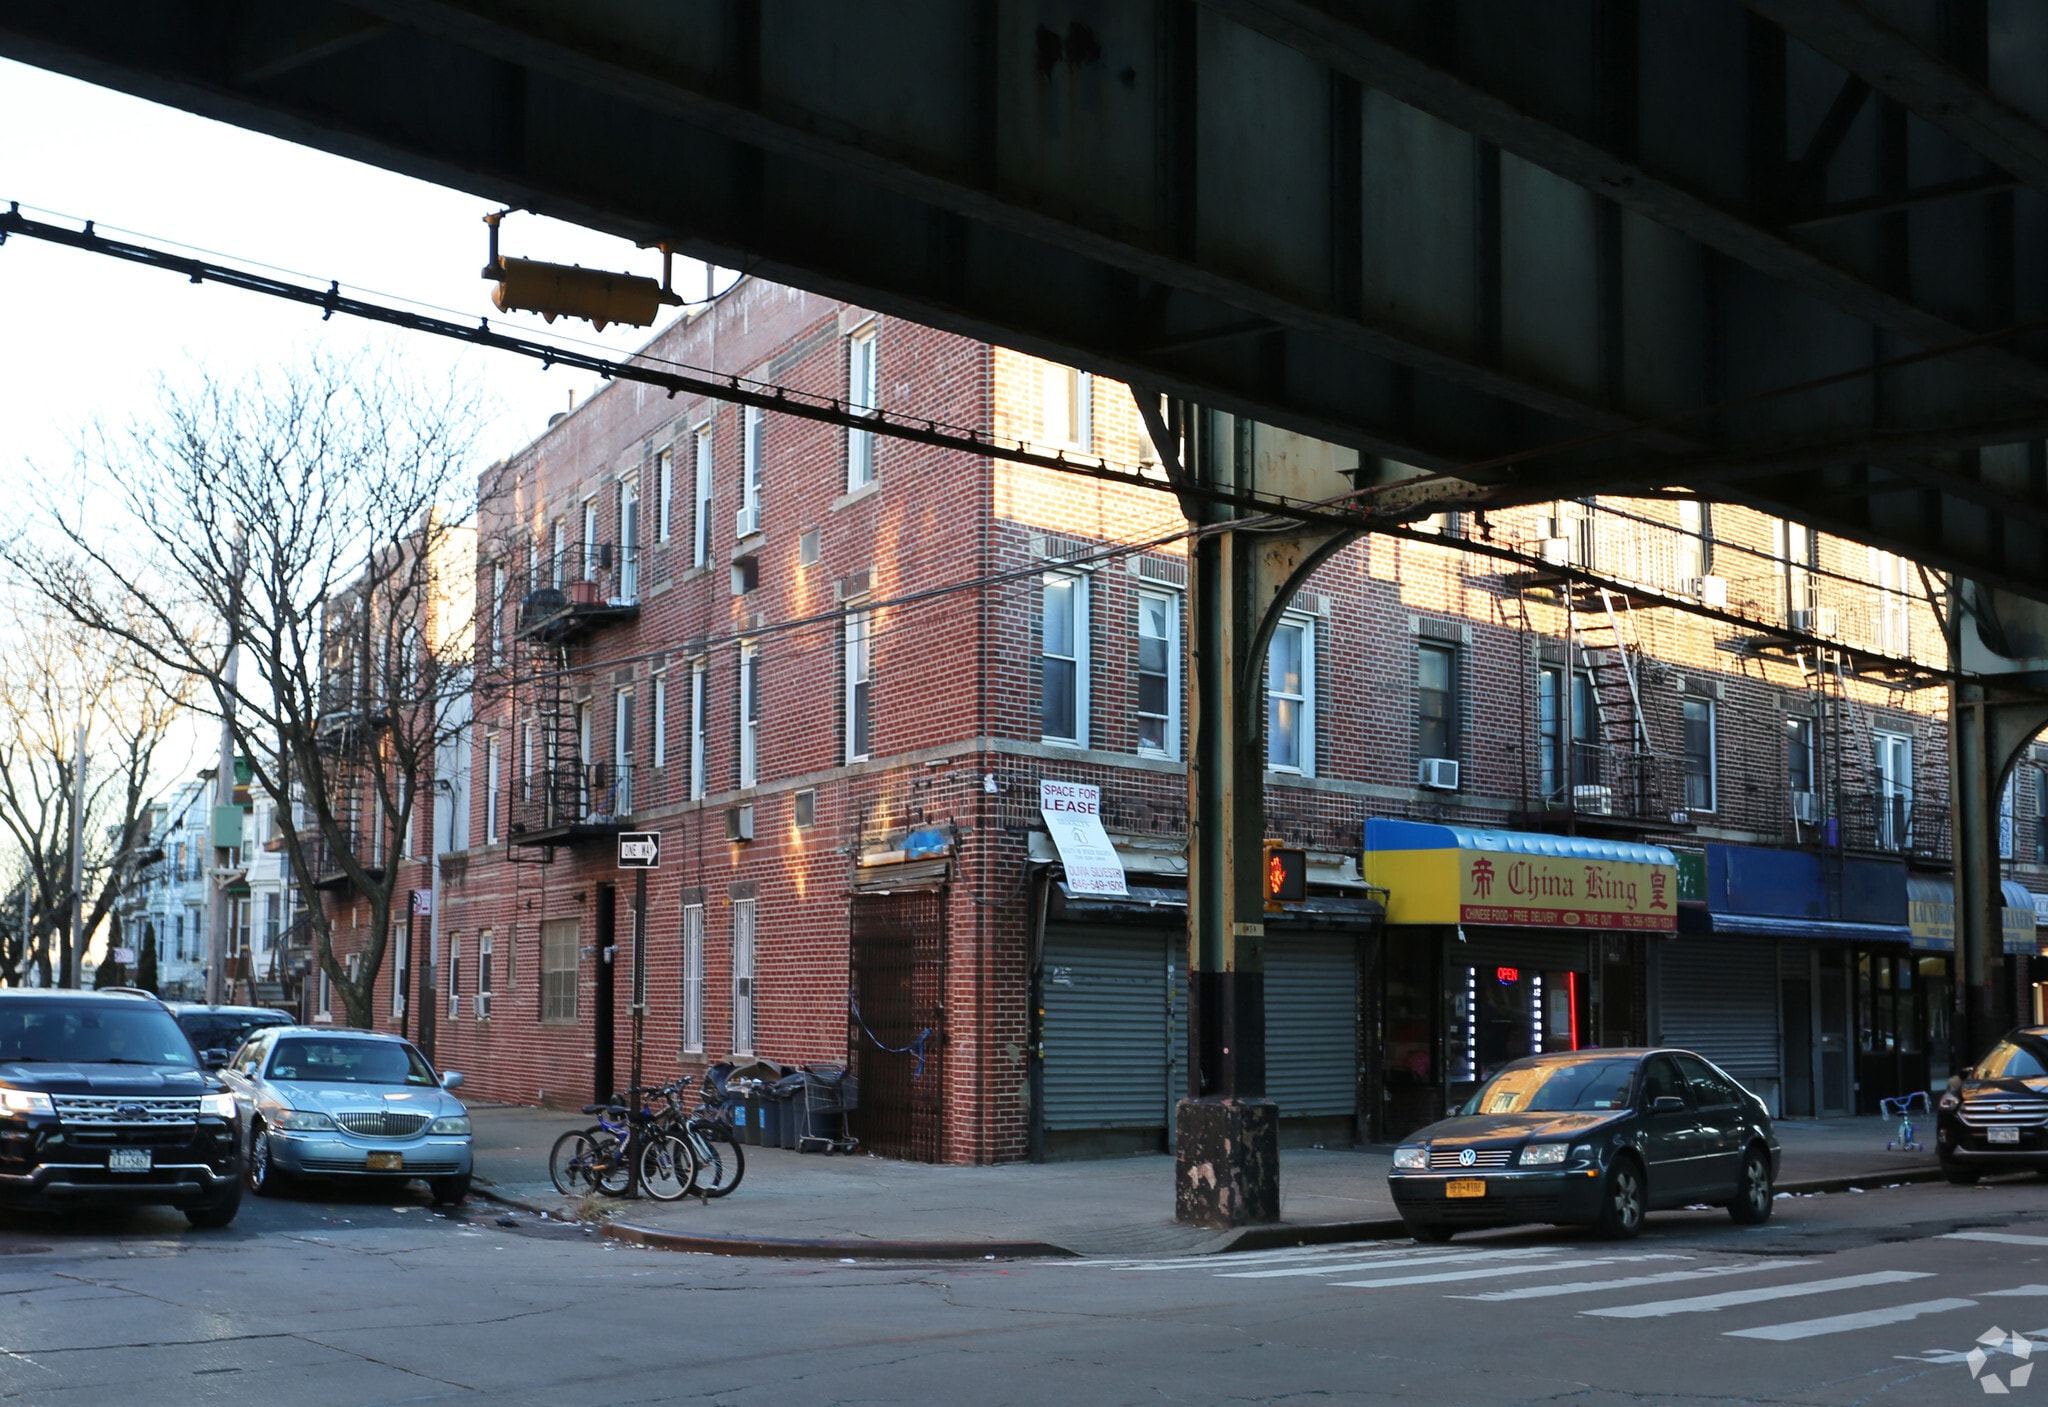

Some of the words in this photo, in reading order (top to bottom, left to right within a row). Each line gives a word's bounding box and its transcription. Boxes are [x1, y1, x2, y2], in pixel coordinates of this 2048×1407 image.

[1044, 784, 1075, 797] SPACE
[1079, 788, 1097, 800] FOR
[1045, 798, 1097, 815] LEASE
[624, 844, 637, 856] ONE
[641, 844, 654, 856] WAY
[1068, 865, 1089, 877] OLIVIA
[1508, 861, 1574, 900] China
[1585, 866, 1637, 910] King
[1650, 868, 1668, 910] 皇
[1465, 909, 1491, 921] CHINESE
[1492, 911, 1508, 921] FOOD
[1513, 912, 1528, 922] FREE
[1531, 912, 1558, 923] DELIVERY
[1584, 913, 1599, 925] TAKE
[1601, 914, 1612, 926] OUT
[1497, 967, 1519, 981] OPEN
